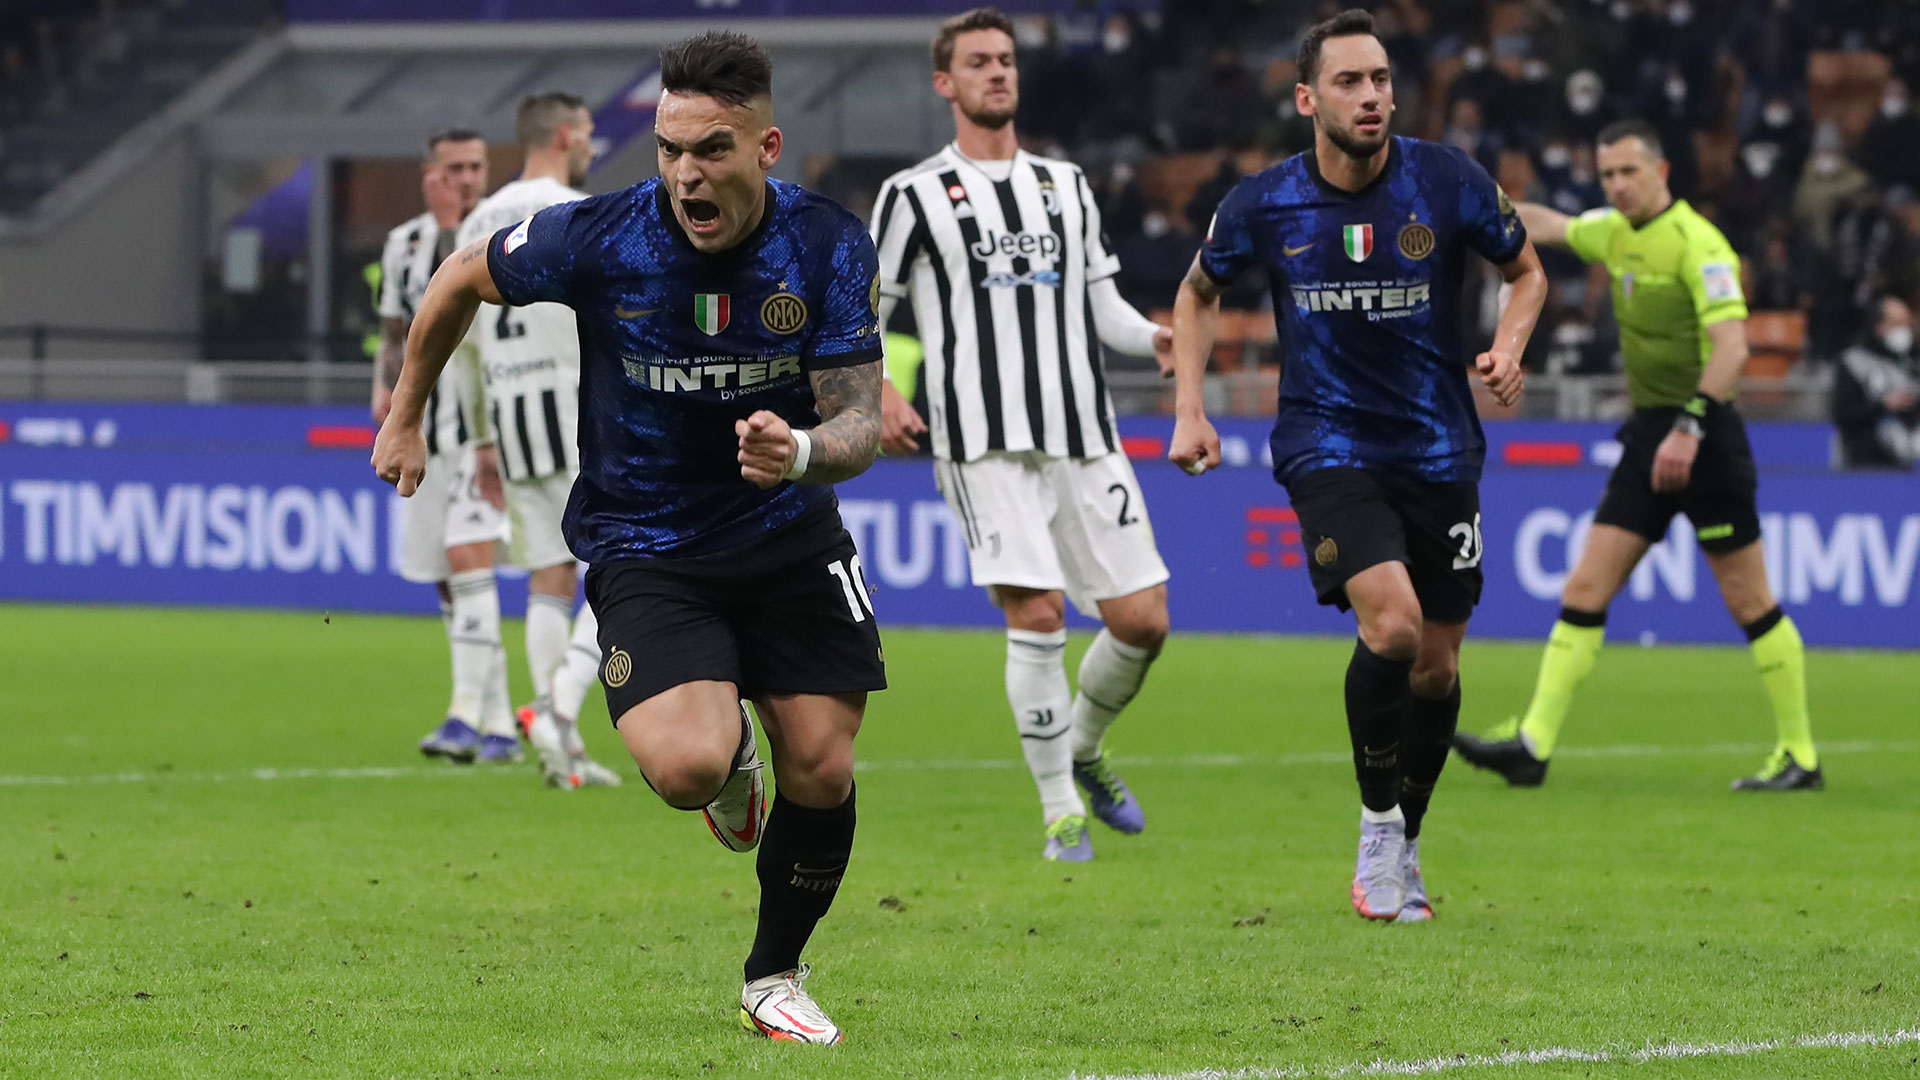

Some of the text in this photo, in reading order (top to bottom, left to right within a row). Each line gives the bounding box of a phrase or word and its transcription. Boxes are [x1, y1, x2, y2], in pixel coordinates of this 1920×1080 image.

[977, 230, 1057, 257] Jeep
[1309, 284, 1430, 312] INTER
[694, 355, 733, 363] SOUND
[649, 356, 800, 392] INTER
[720, 389, 737, 400] by
[1107, 483, 1138, 527] 2
[9, 480, 376, 574] TIMVISION
